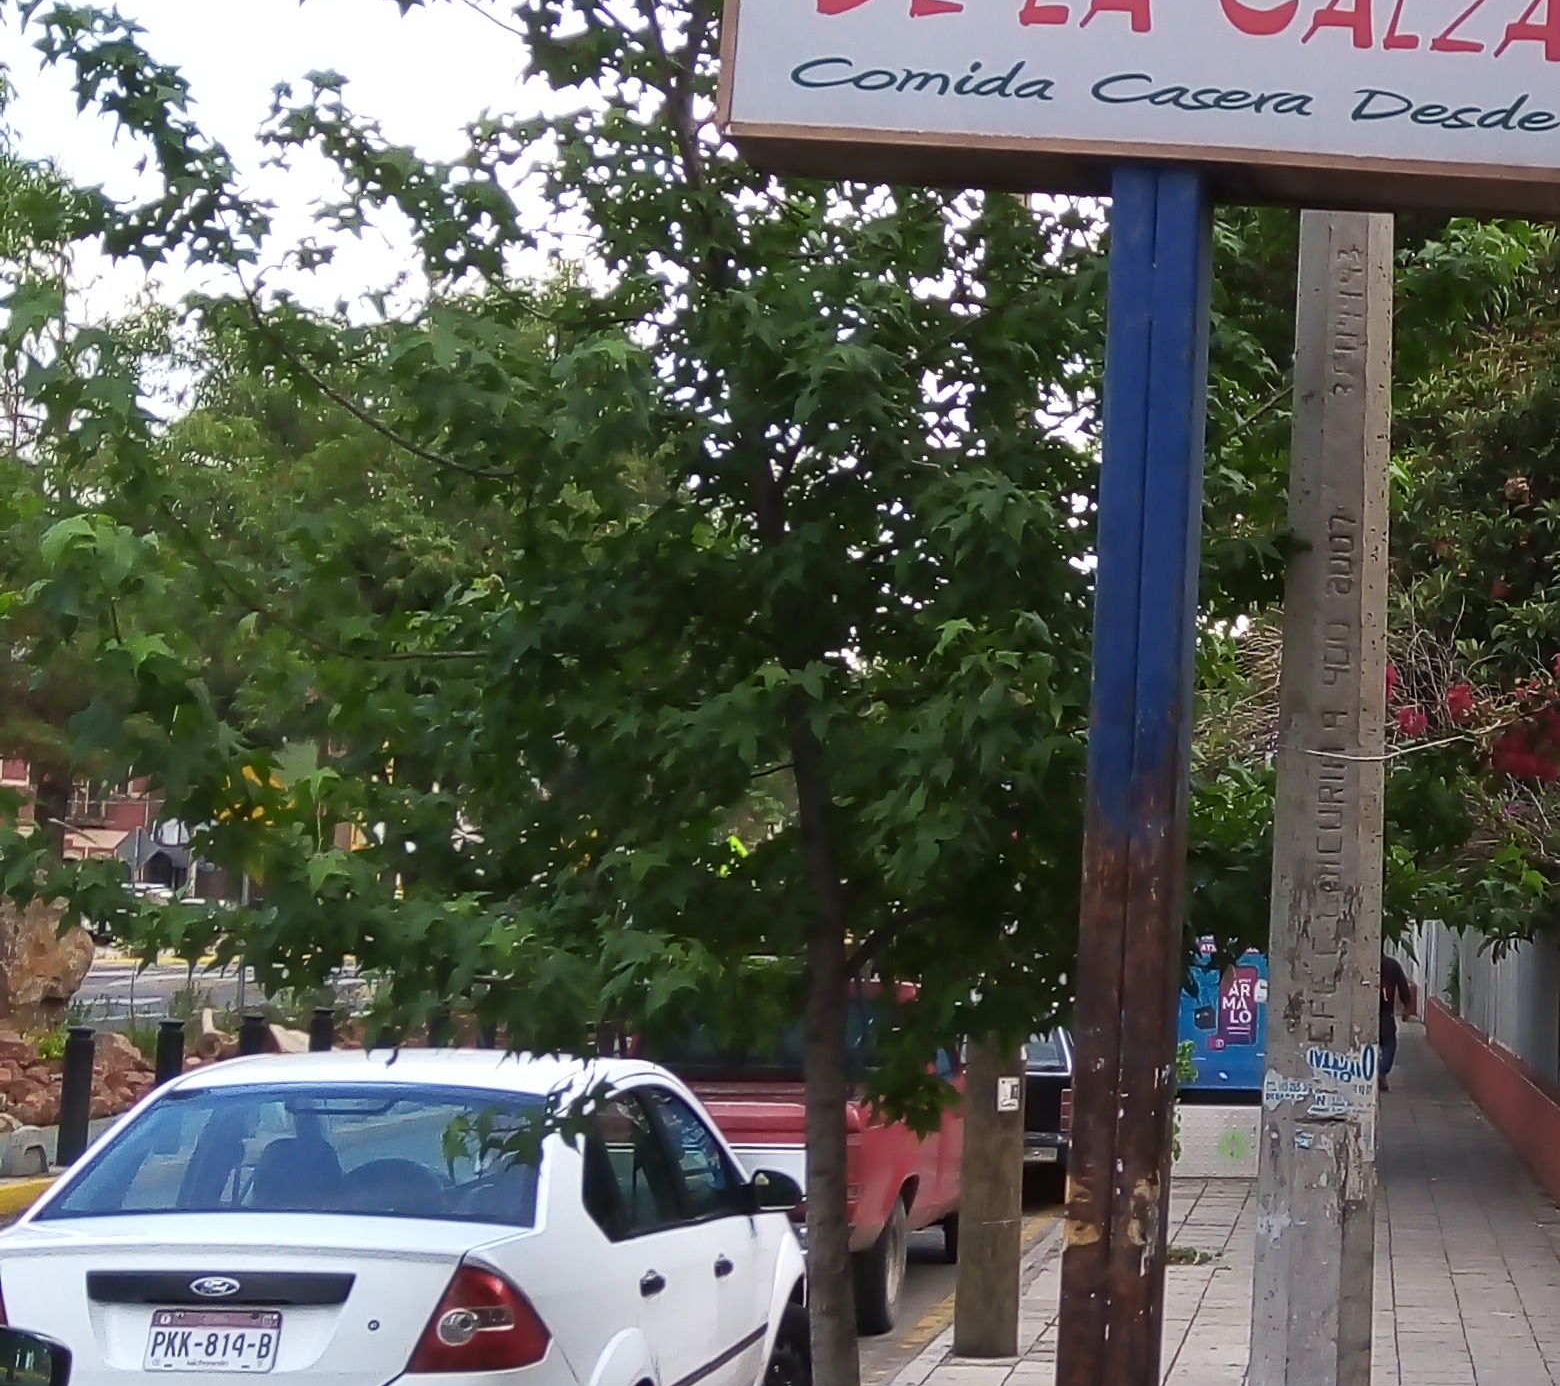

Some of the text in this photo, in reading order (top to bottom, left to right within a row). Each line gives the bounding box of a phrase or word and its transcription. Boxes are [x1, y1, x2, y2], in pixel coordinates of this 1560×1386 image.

[790, 57, 1053, 101] Comida
[1091, 73, 1312, 117] Casera
[1350, 88, 1560, 134] Desde
[1229, 1010, 1252, 1025] LO
[151, 1329, 273, 1360] PKK-814-B
